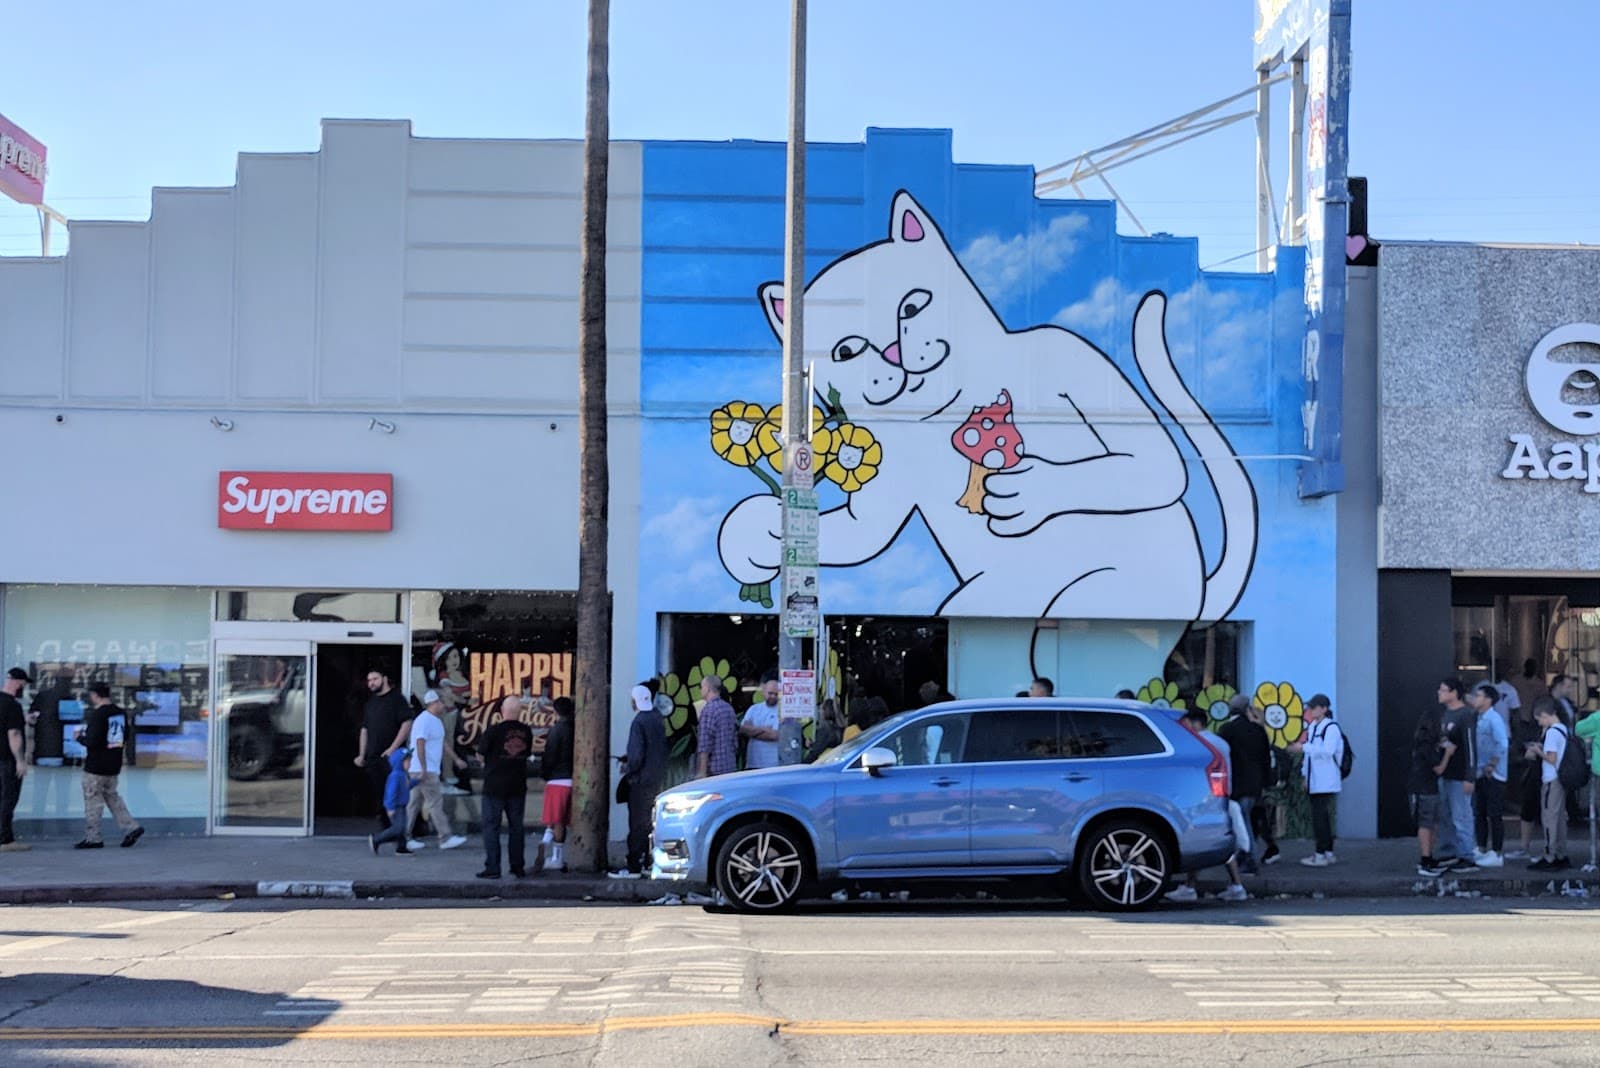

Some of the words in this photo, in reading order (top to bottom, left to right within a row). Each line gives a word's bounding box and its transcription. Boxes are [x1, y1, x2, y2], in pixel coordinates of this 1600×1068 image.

[223, 476, 387, 524] Supreme
[470, 652, 572, 702] HAPPY
[785, 696, 797, 705] ANY
